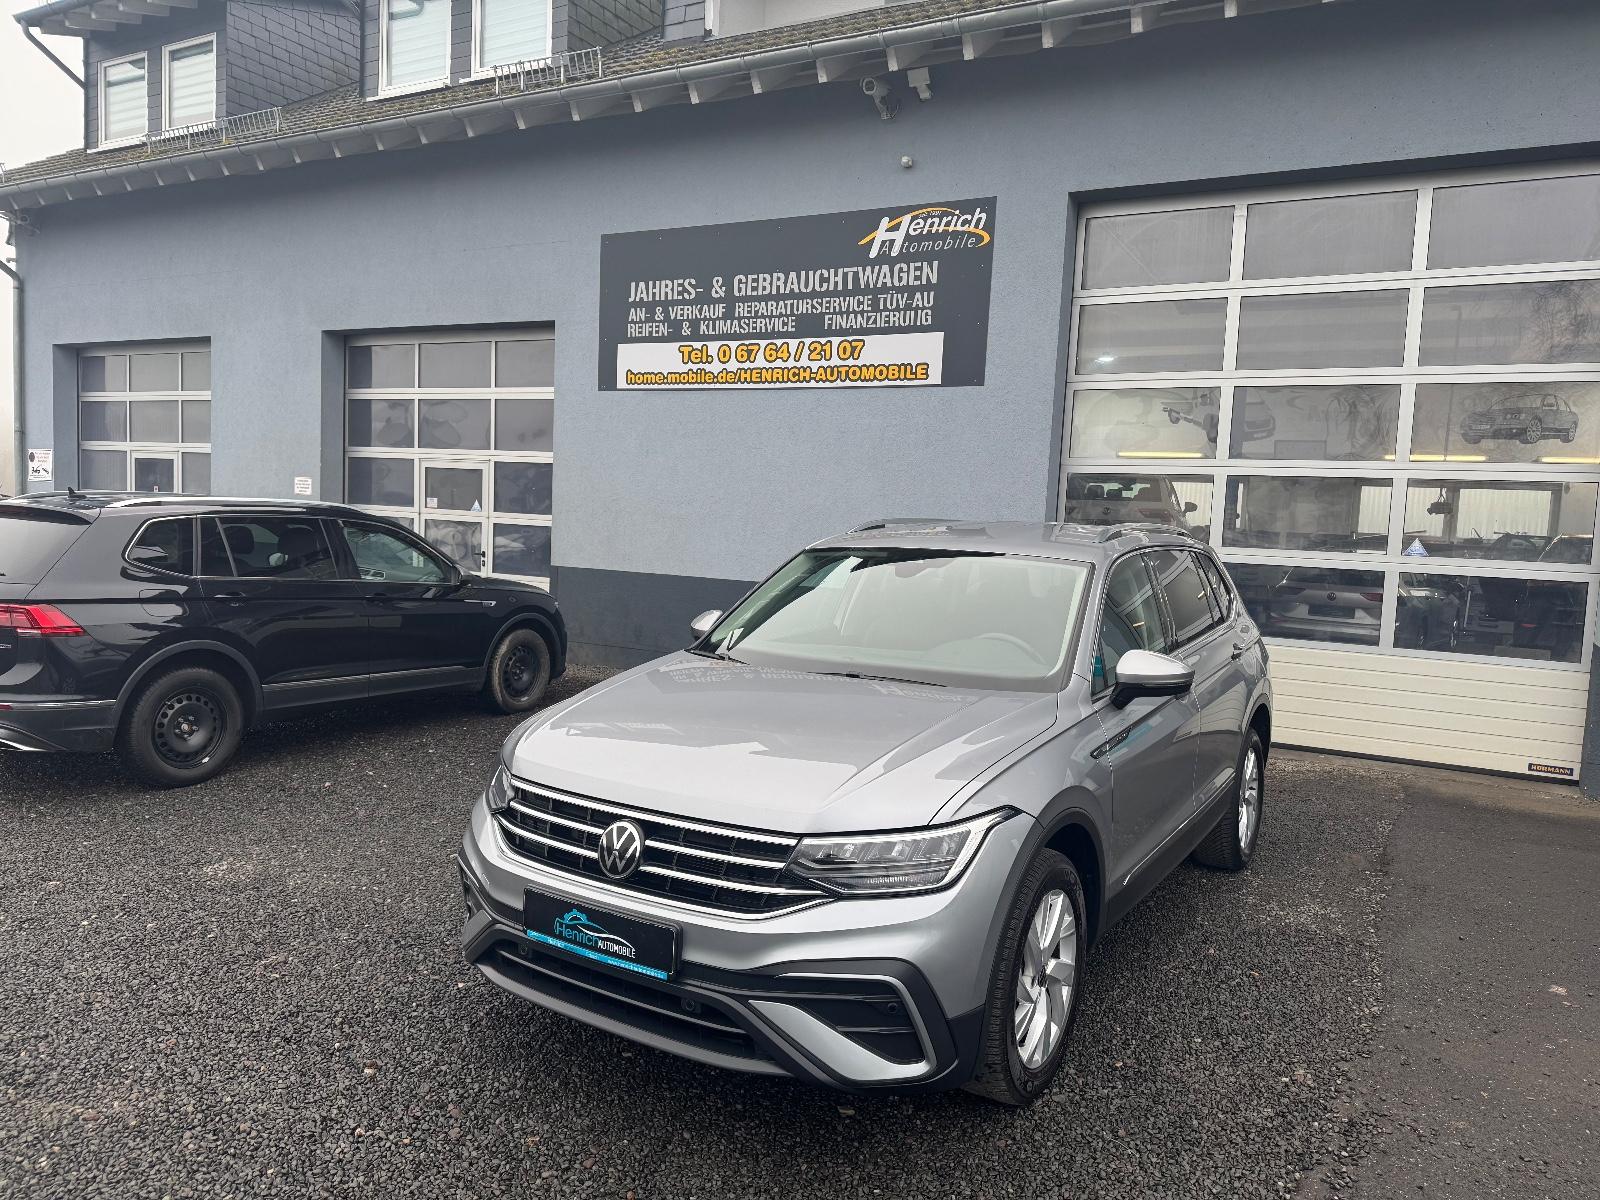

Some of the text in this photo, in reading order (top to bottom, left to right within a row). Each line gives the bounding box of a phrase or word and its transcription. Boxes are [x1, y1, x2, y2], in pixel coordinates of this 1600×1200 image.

[868, 207, 987, 259] Henrich
[628, 260, 939, 302] JAHRES- & GEBRAUCHTWAGEN
[628, 290, 935, 322] AN- & VERKAUF REPARATURSERVICE TÜV-AU
[627, 322, 673, 338] REIFEN-
[681, 321, 692, 336] &
[699, 316, 796, 335] KLIMASERVICE
[679, 338, 865, 364] Tel. 0 67 64 / 21 07
[626, 362, 929, 385] home.mobile.de/HENRICH-AUTOMOBILE
[556, 923, 600, 948] Henrich
[598, 939, 636, 959] AUTOMOBILE
